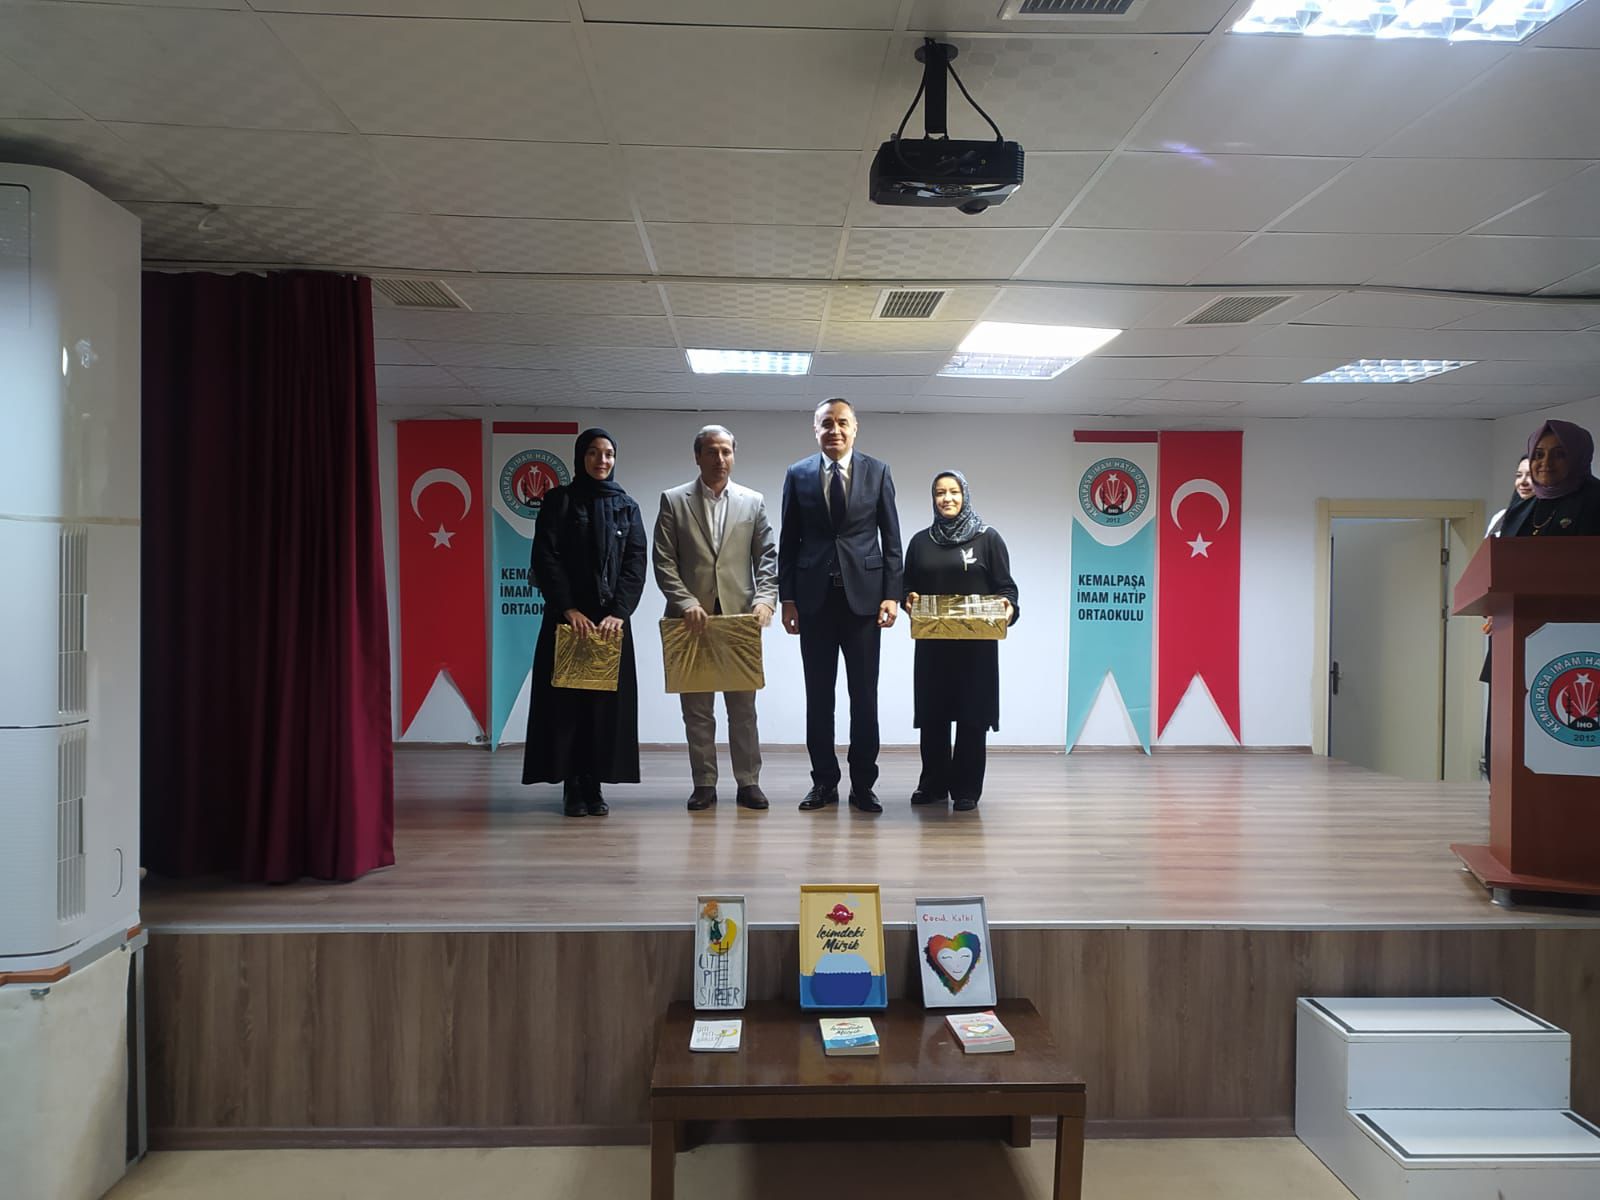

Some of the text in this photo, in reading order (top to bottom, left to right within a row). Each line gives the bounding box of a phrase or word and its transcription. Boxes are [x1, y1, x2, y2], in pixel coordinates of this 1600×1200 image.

[1078, 574, 1145, 590] KEMALPAŞA
[500, 583, 533, 598] İMAM
[1077, 588, 1147, 604] İMAM HATİP
[1078, 608, 1144, 621] ORTAOKULU
[1573, 734, 1597, 742] 2012
[816, 924, 867, 940] İçimdeki
[822, 938, 860, 953] Müzik
